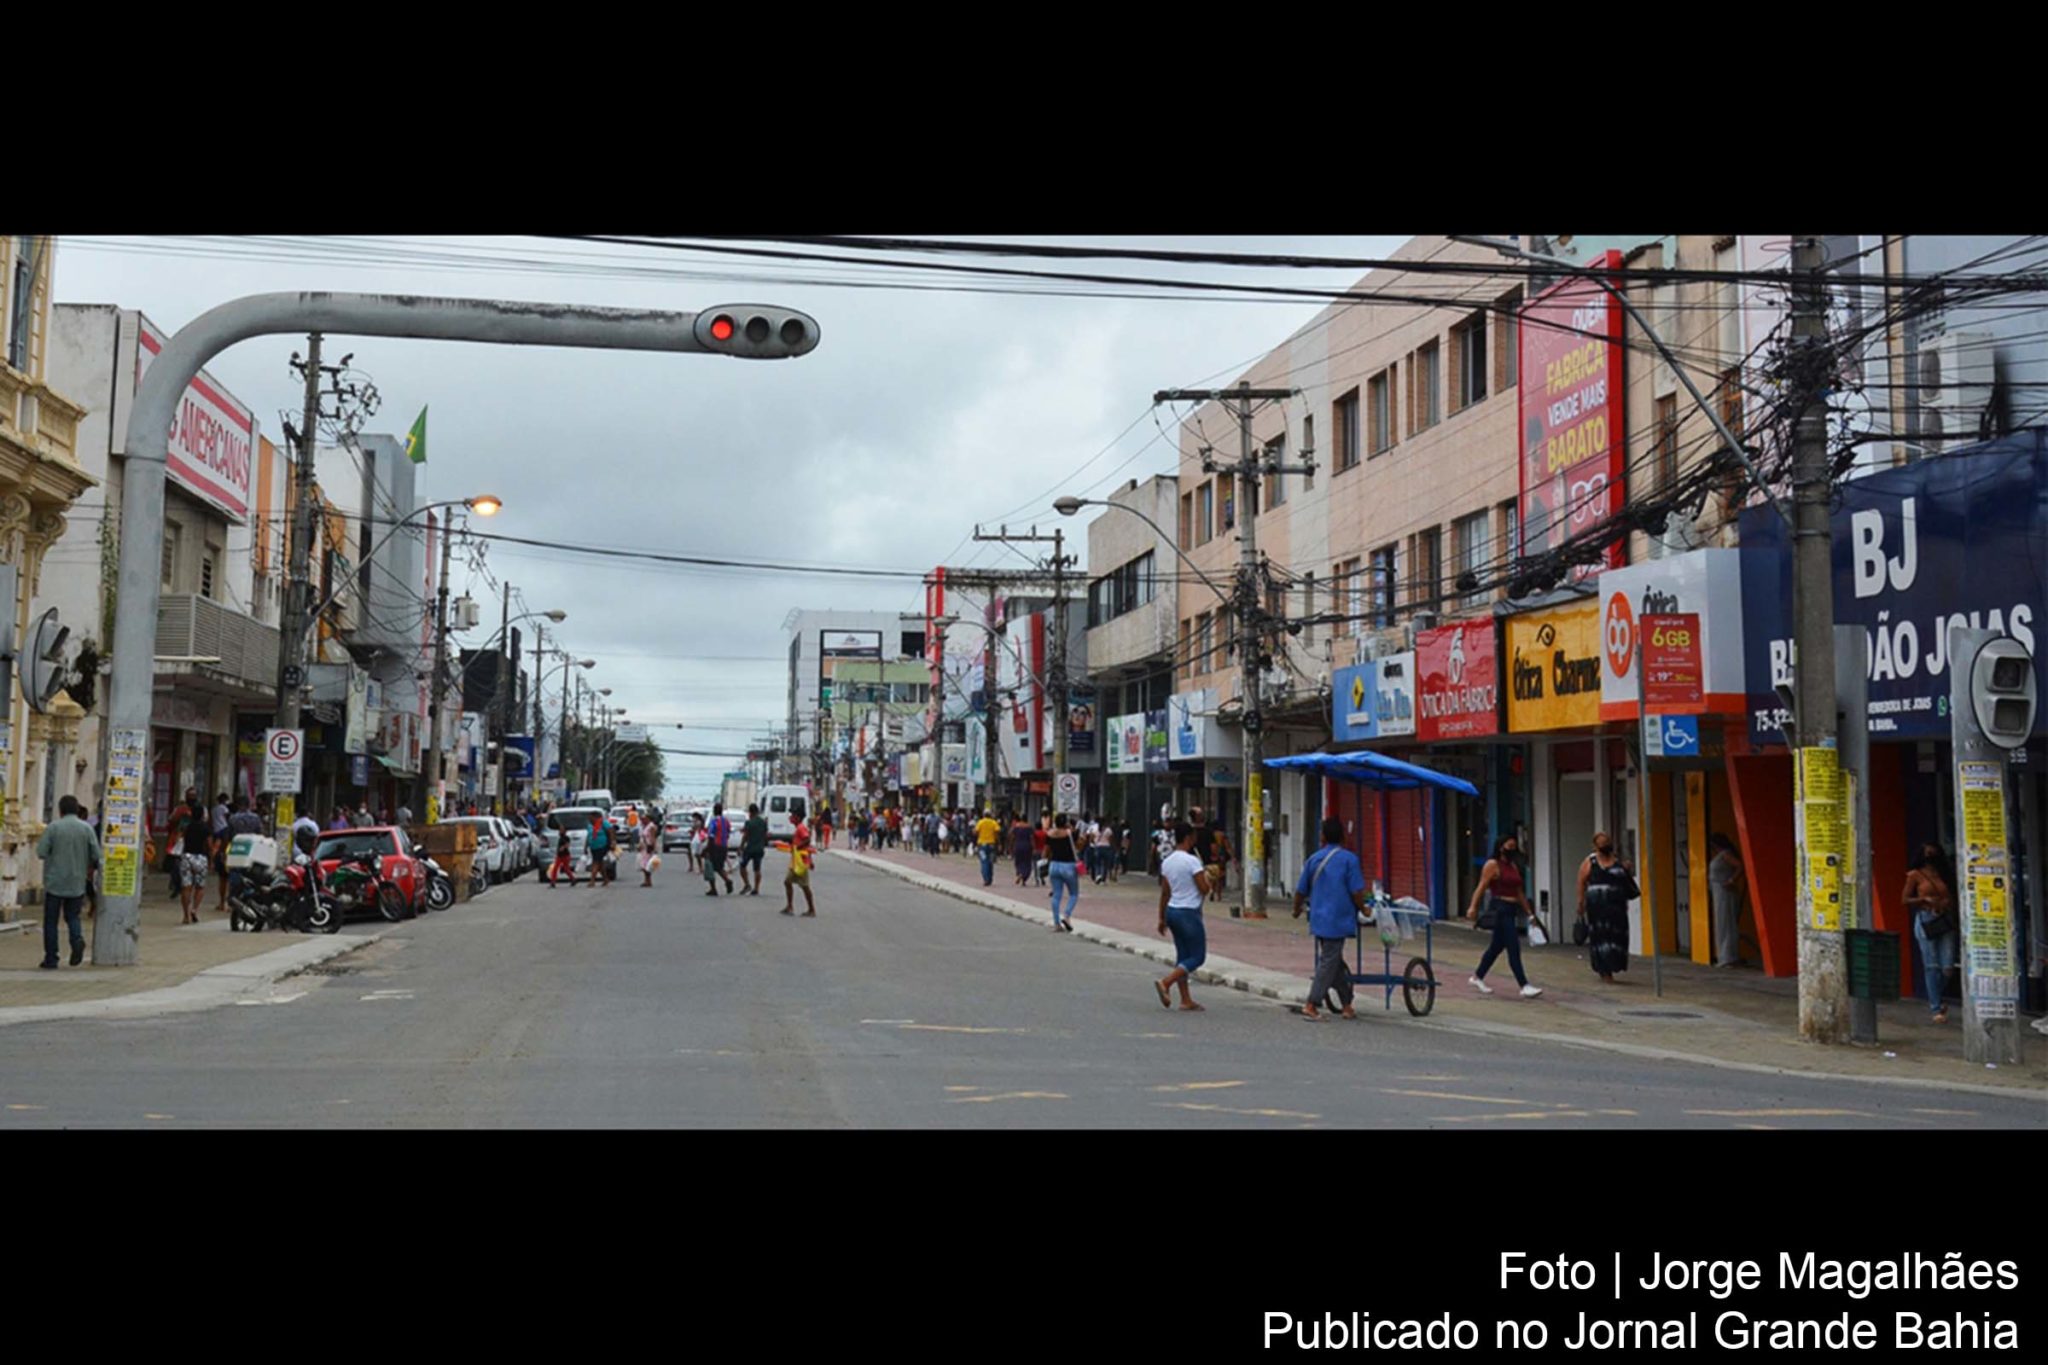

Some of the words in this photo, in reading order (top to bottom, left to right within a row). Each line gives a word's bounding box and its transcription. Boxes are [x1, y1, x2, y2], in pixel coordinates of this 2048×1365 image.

[1546, 340, 1606, 395] FABRICA
[1548, 393, 1581, 428] VENDE
[1581, 380, 1607, 411] MAIS
[178, 397, 250, 494] AMERICANAS
[1548, 415, 1607, 474] BARATO
[1851, 497, 1918, 598] BJ
[1513, 646, 1543, 701] Ótica
[1553, 650, 1600, 696] Charme
[1447, 689, 1461, 716] DA
[277, 736, 291, 755] E
